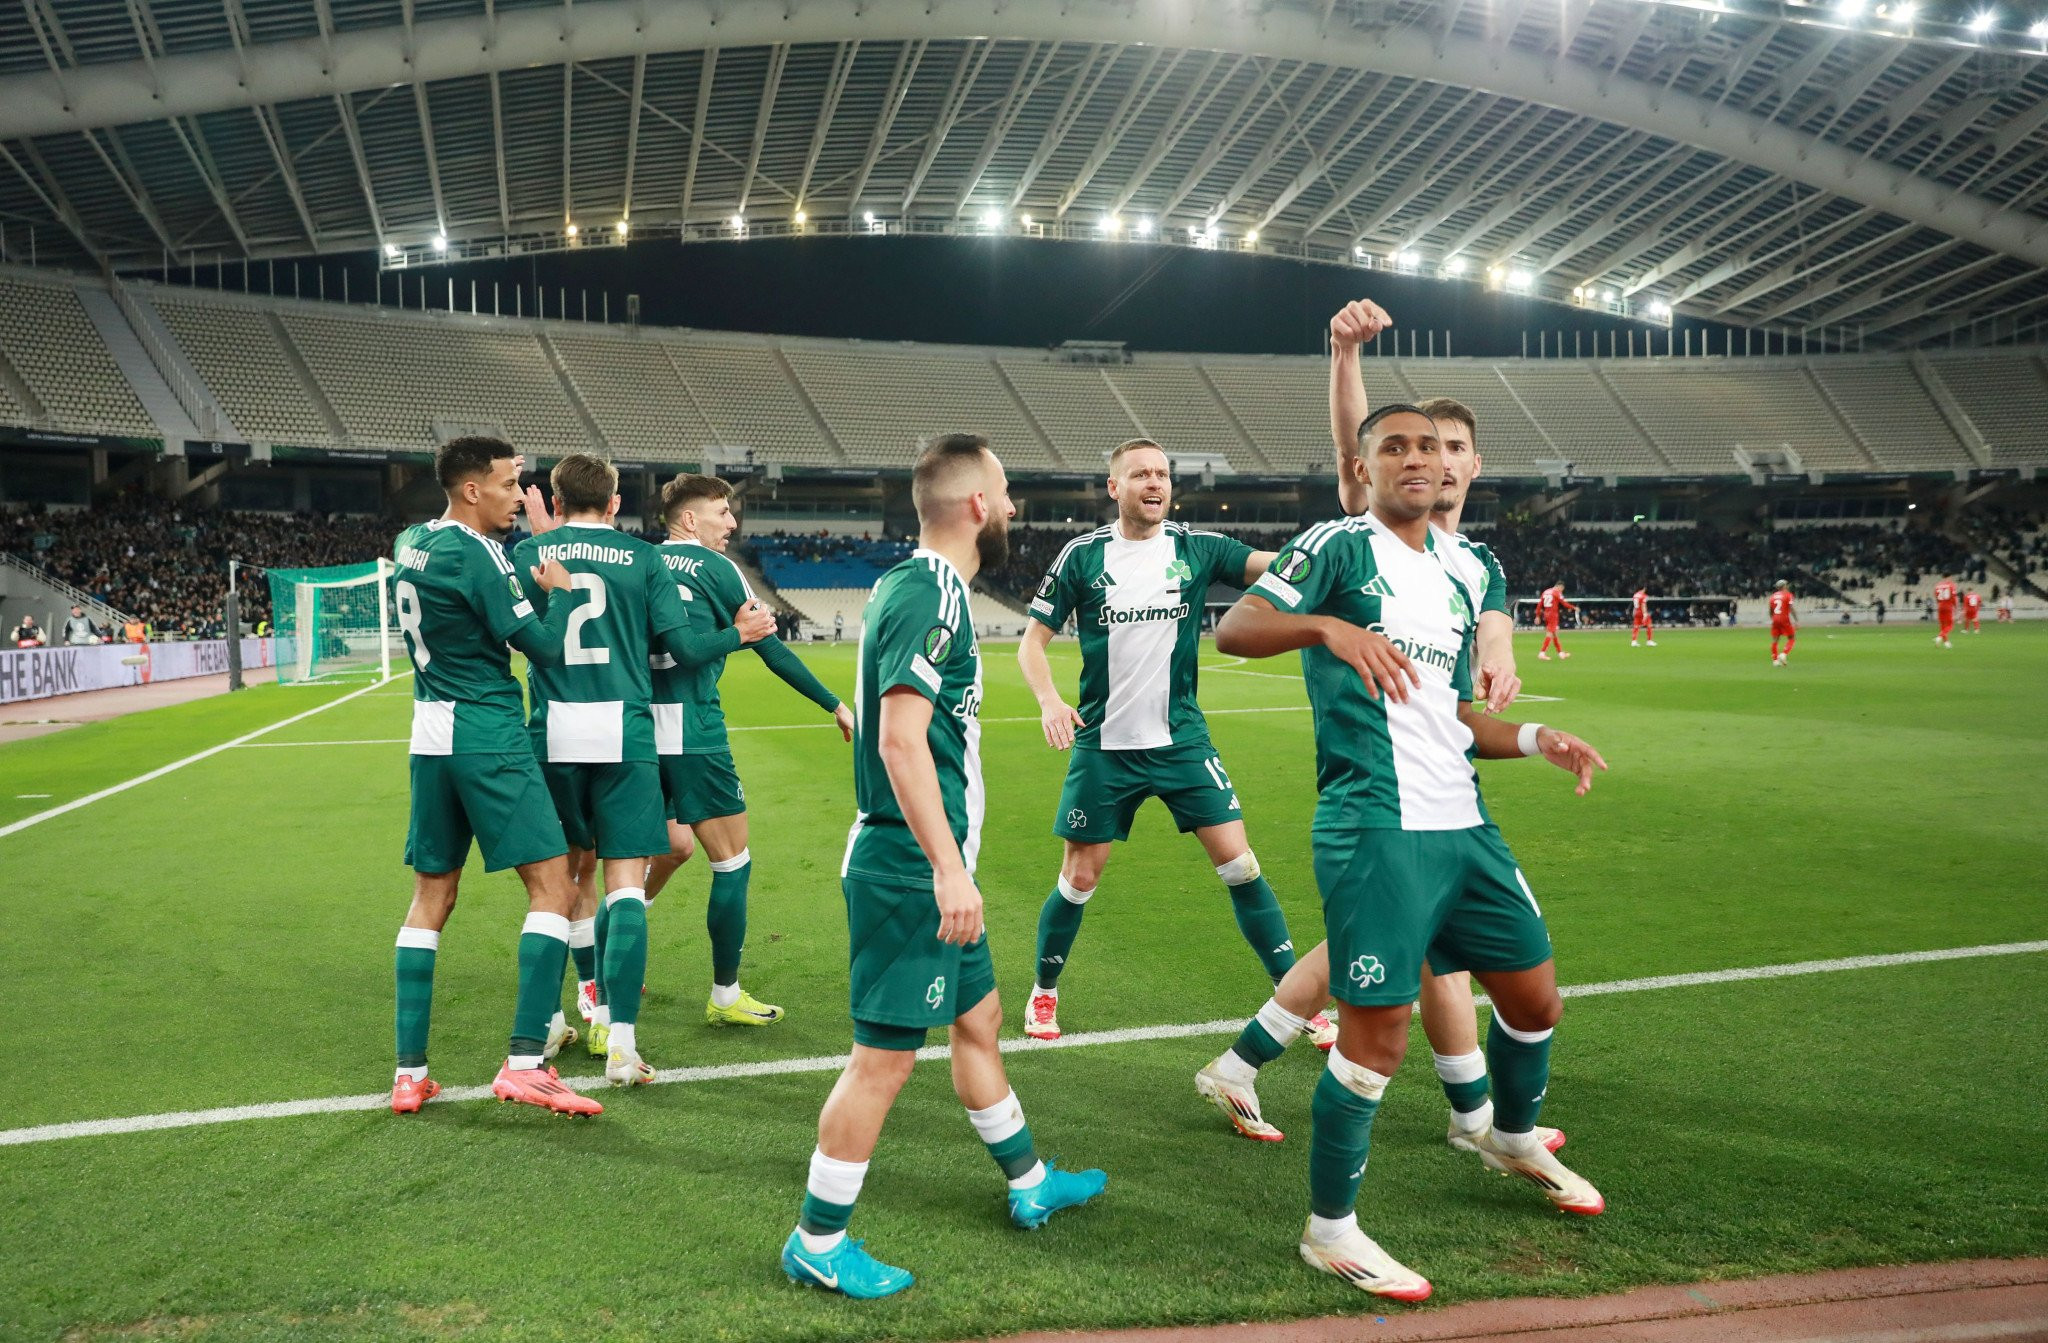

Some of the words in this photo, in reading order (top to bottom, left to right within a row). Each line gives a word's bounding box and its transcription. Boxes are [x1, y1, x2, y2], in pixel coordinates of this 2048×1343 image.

[538, 543, 634, 566] VAGIANNIDIS
[564, 572, 610, 666] 2
[1099, 603, 1189, 626] Stoiximan
[1773, 599, 1783, 615] 2
[193, 643, 213, 672] THE
[213, 643, 230, 671] BAN
[1366, 622, 1457, 673] oixima
[0, 654, 27, 699] HE
[32, 650, 78, 695] BANK
[1204, 756, 1232, 791] 15
